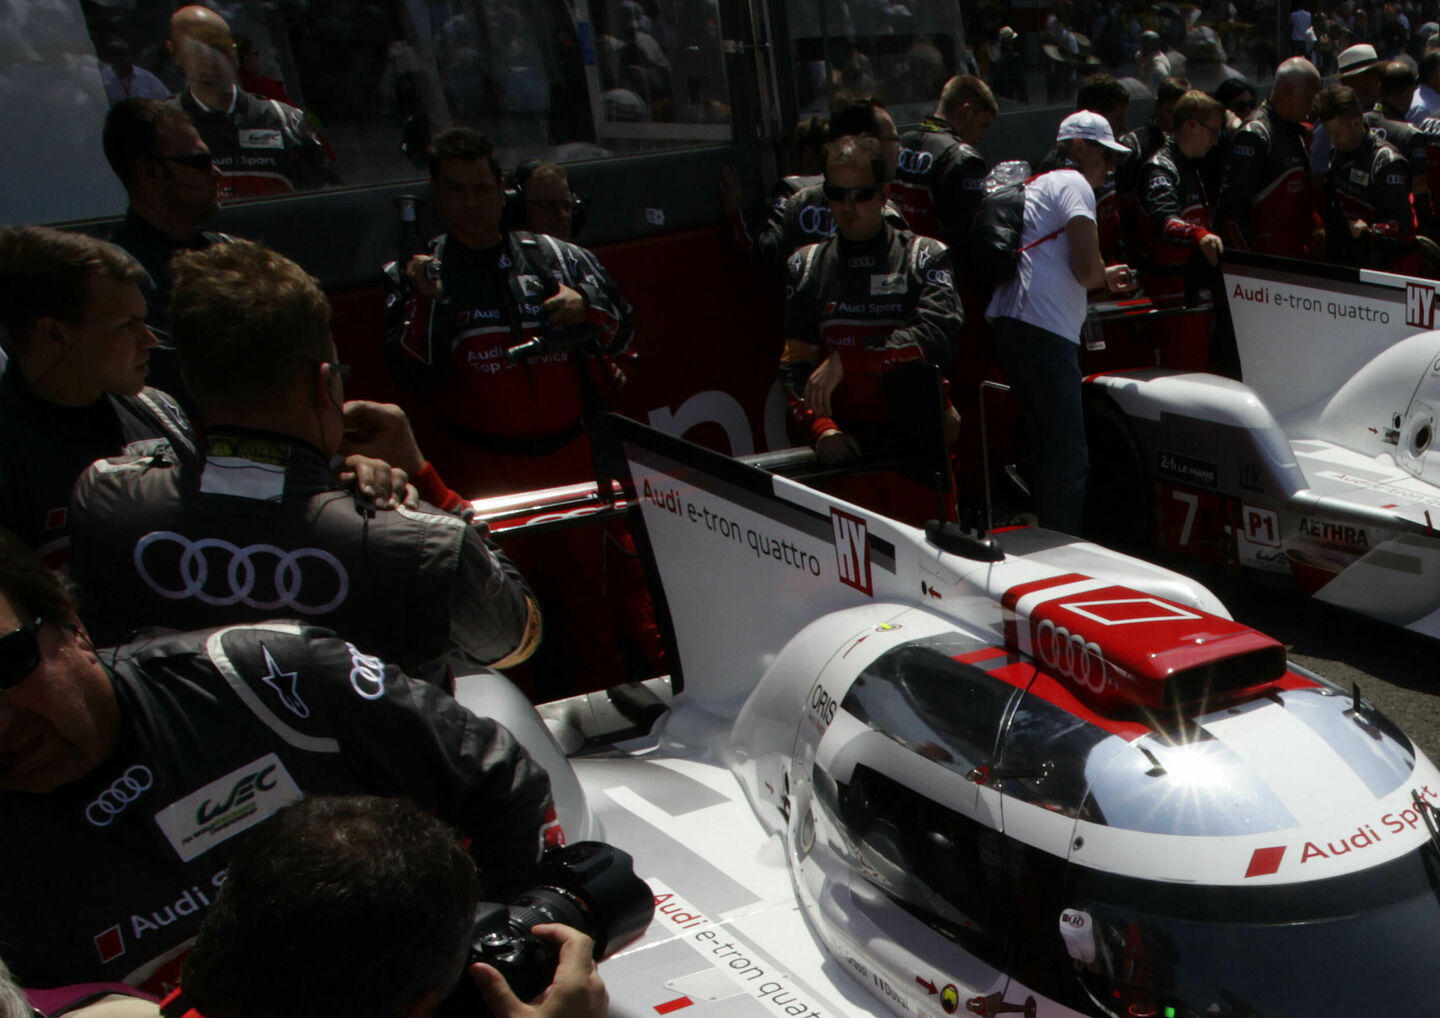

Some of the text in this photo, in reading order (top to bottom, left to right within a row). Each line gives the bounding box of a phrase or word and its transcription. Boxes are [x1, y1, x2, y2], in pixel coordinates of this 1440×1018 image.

[838, 303, 902, 315] Audi Sport
[1233, 283, 1390, 325] Audi e-tron quattro
[1407, 286, 1434, 327] HY
[826, 335, 855, 346] Audi
[643, 478, 821, 578] Audi e-tron quattro
[1172, 489, 1199, 547] 7
[1249, 511, 1275, 541] P1
[1299, 517, 1369, 547] AETHRA
[832, 512, 868, 590] HY
[811, 685, 837, 726] ORIS
[197, 763, 278, 826] WEC
[1301, 785, 1438, 865] Audi Sport
[129, 885, 210, 940] Audi
[653, 893, 708, 929] Audi
[695, 930, 764, 981] e-tron
